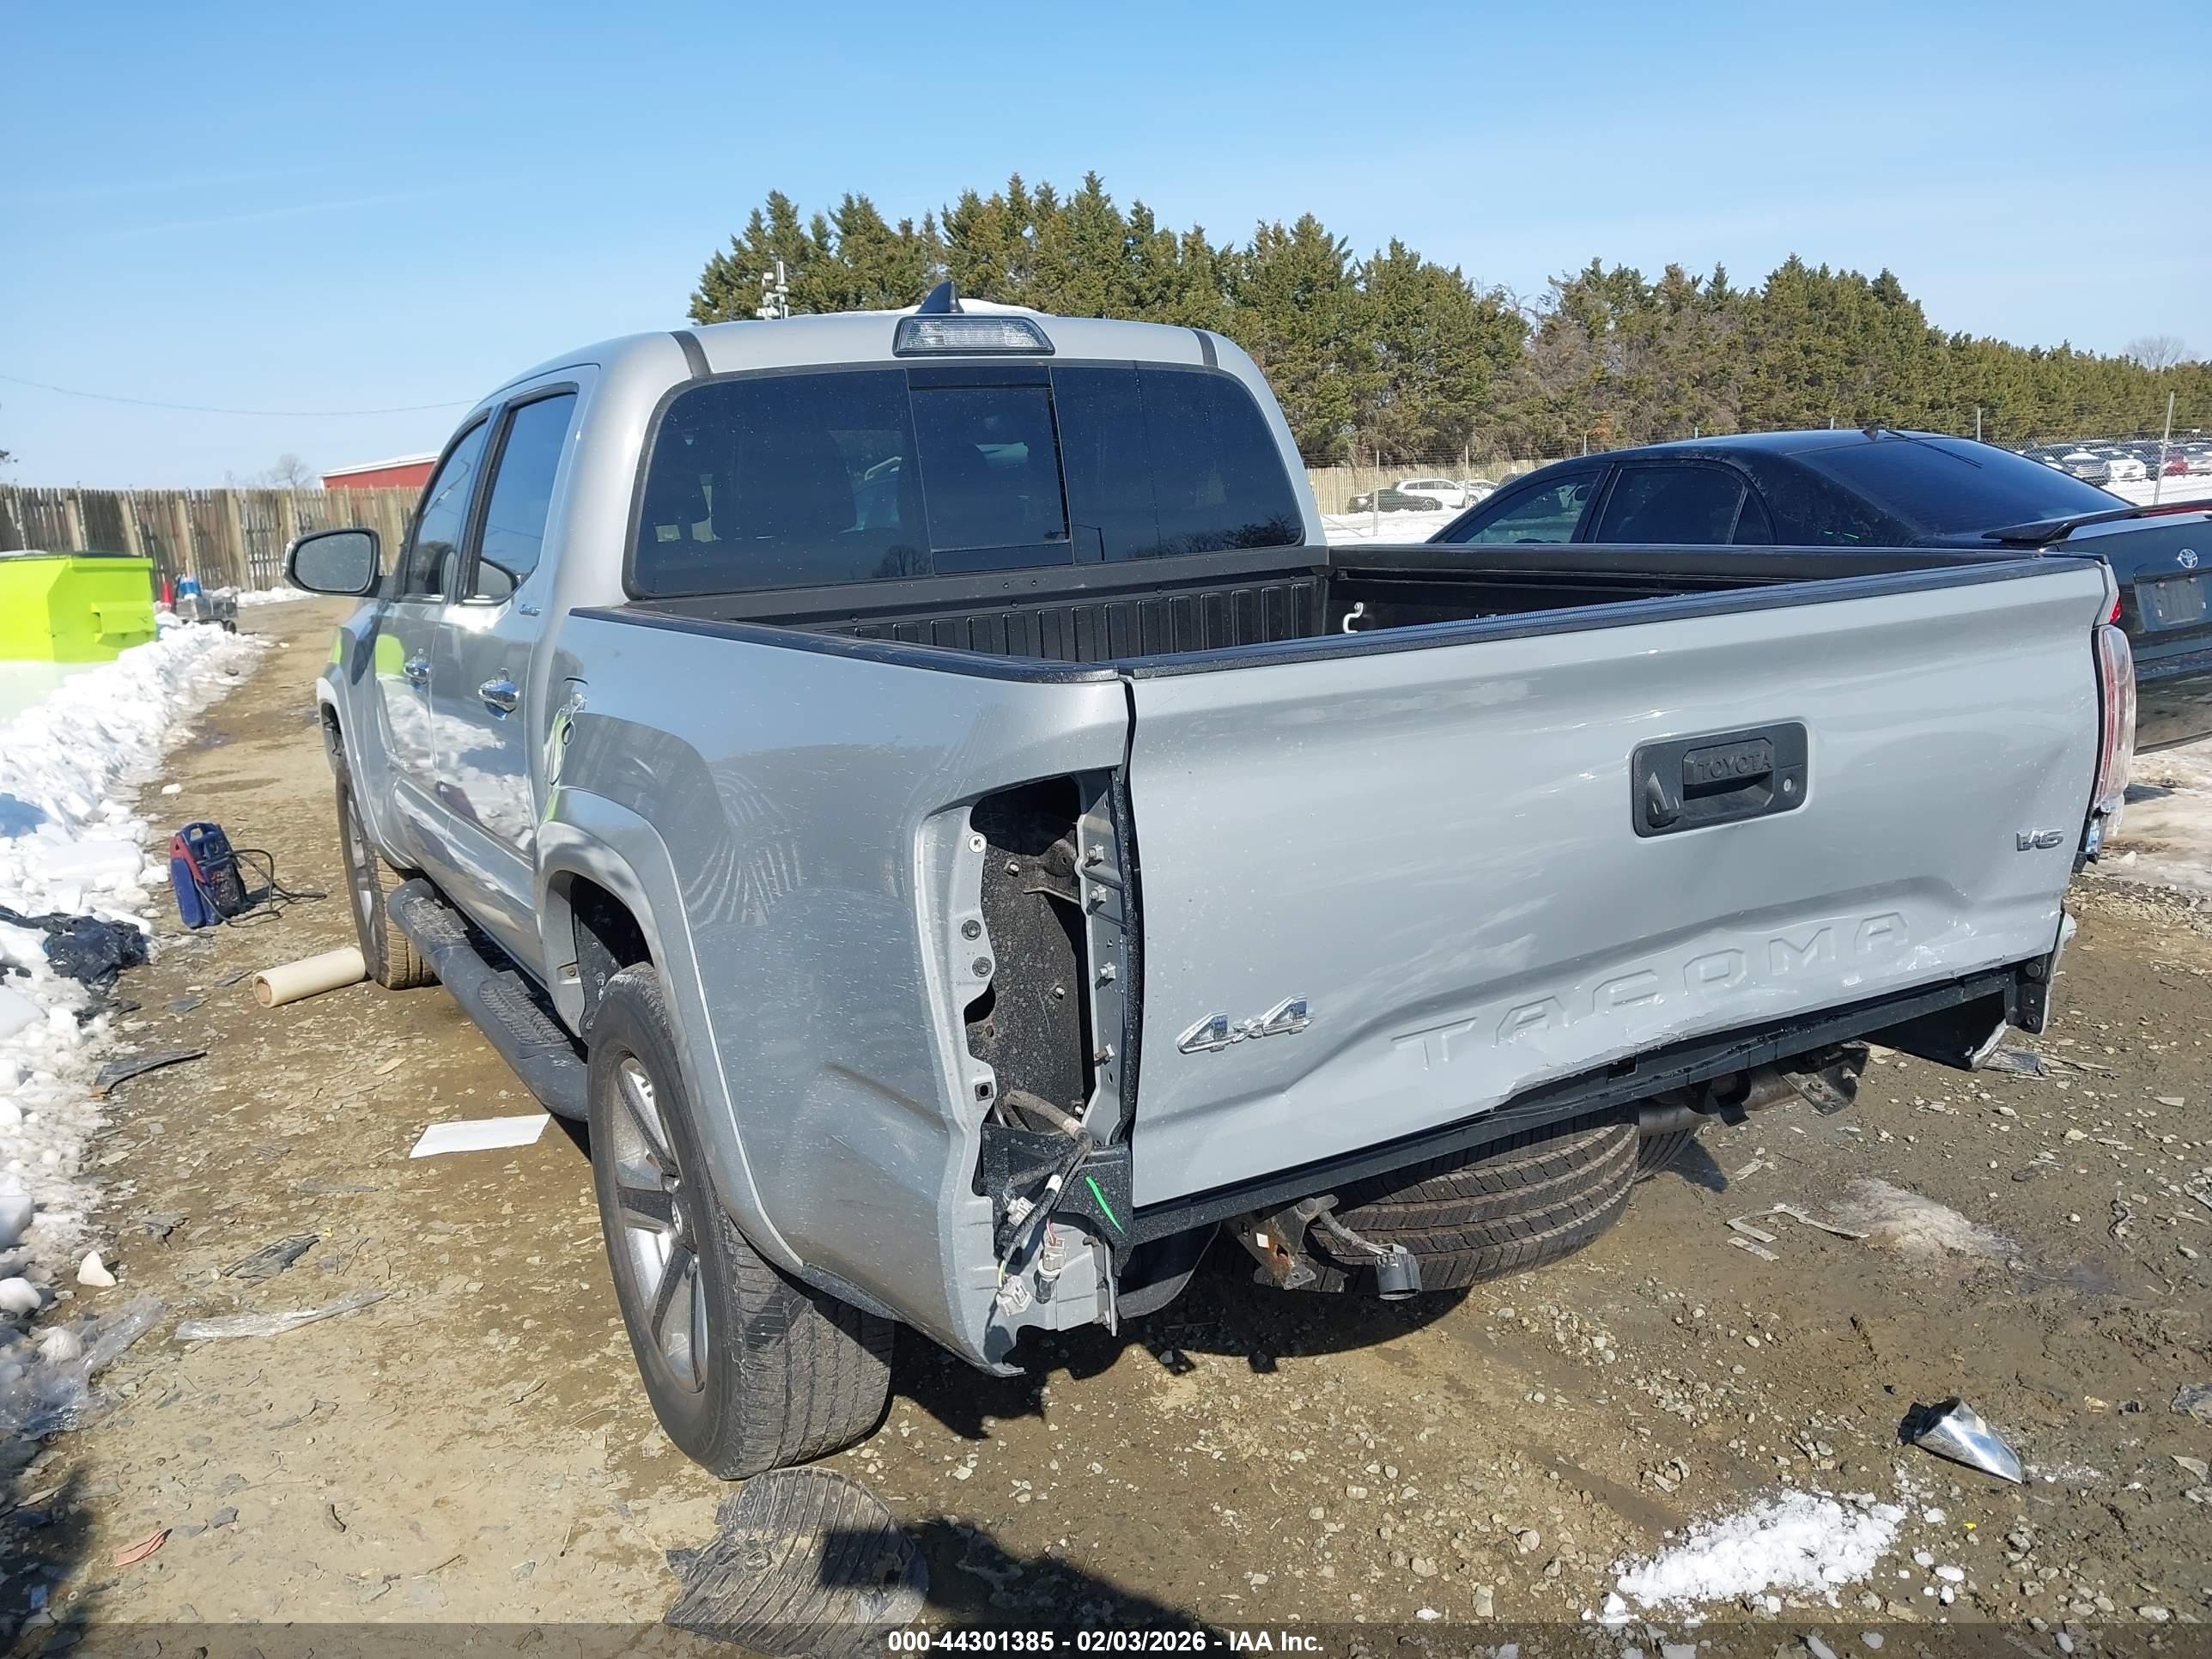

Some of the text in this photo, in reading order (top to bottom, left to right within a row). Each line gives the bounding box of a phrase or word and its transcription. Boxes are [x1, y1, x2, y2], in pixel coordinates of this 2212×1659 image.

[1697, 750, 1773, 781] TOYOTA
[2015, 830, 2064, 852] V6
[1389, 911, 1911, 1071] TACOMA
